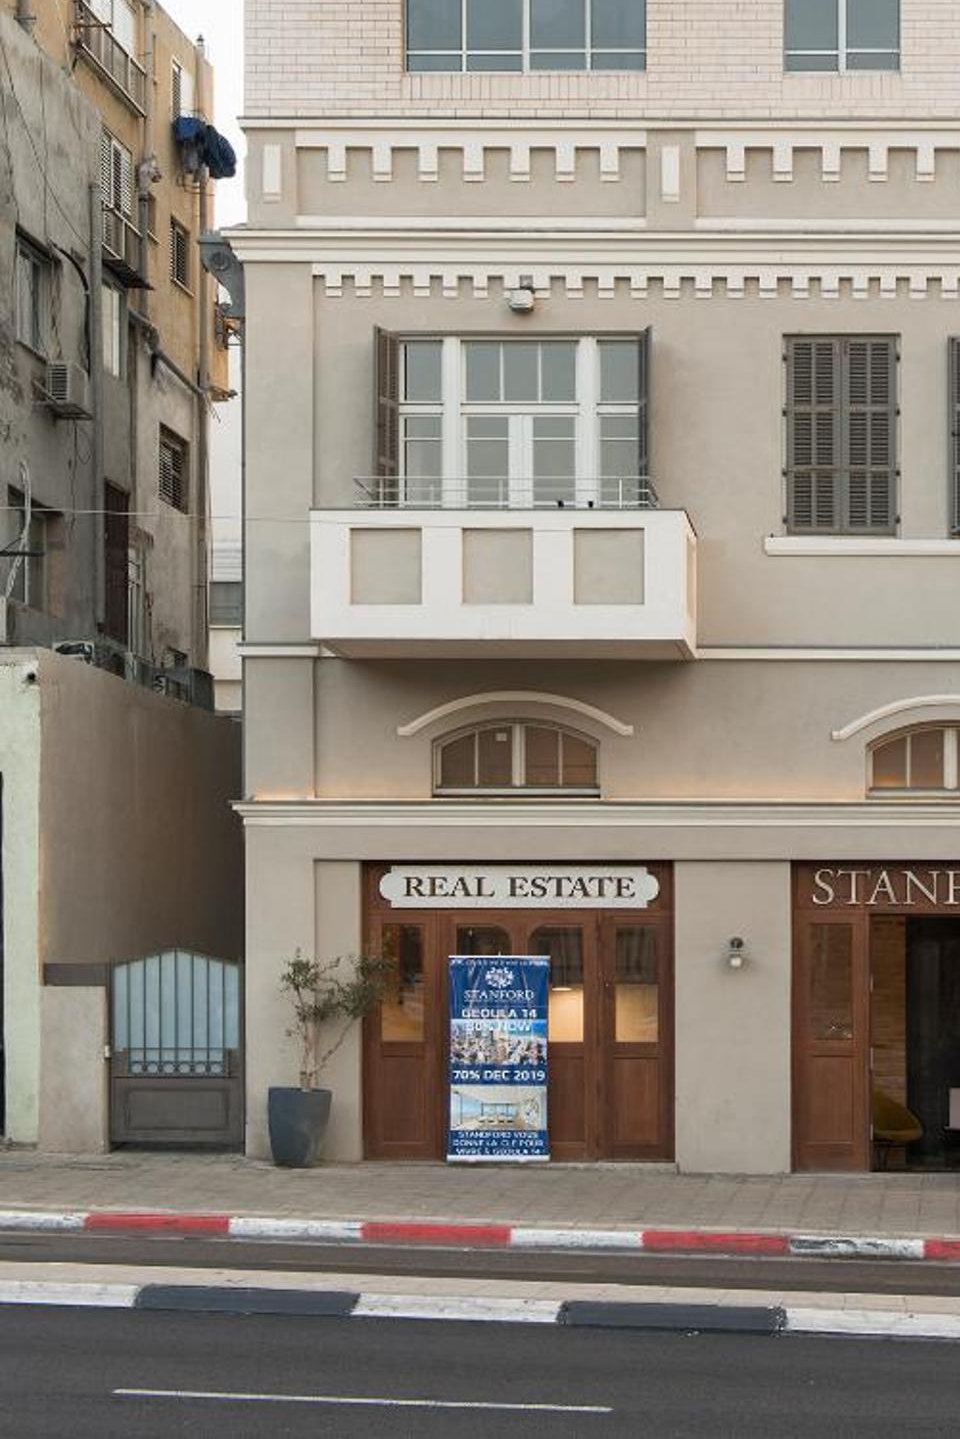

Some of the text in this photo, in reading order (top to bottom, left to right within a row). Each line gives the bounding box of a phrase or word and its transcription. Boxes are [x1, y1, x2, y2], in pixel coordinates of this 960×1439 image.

[404, 876, 636, 899] REAL ESTATE
[464, 989, 534, 1001] STANFORD
[522, 1008, 537, 1018] 14
[452, 1070, 546, 1080] 70% DEC 2019
